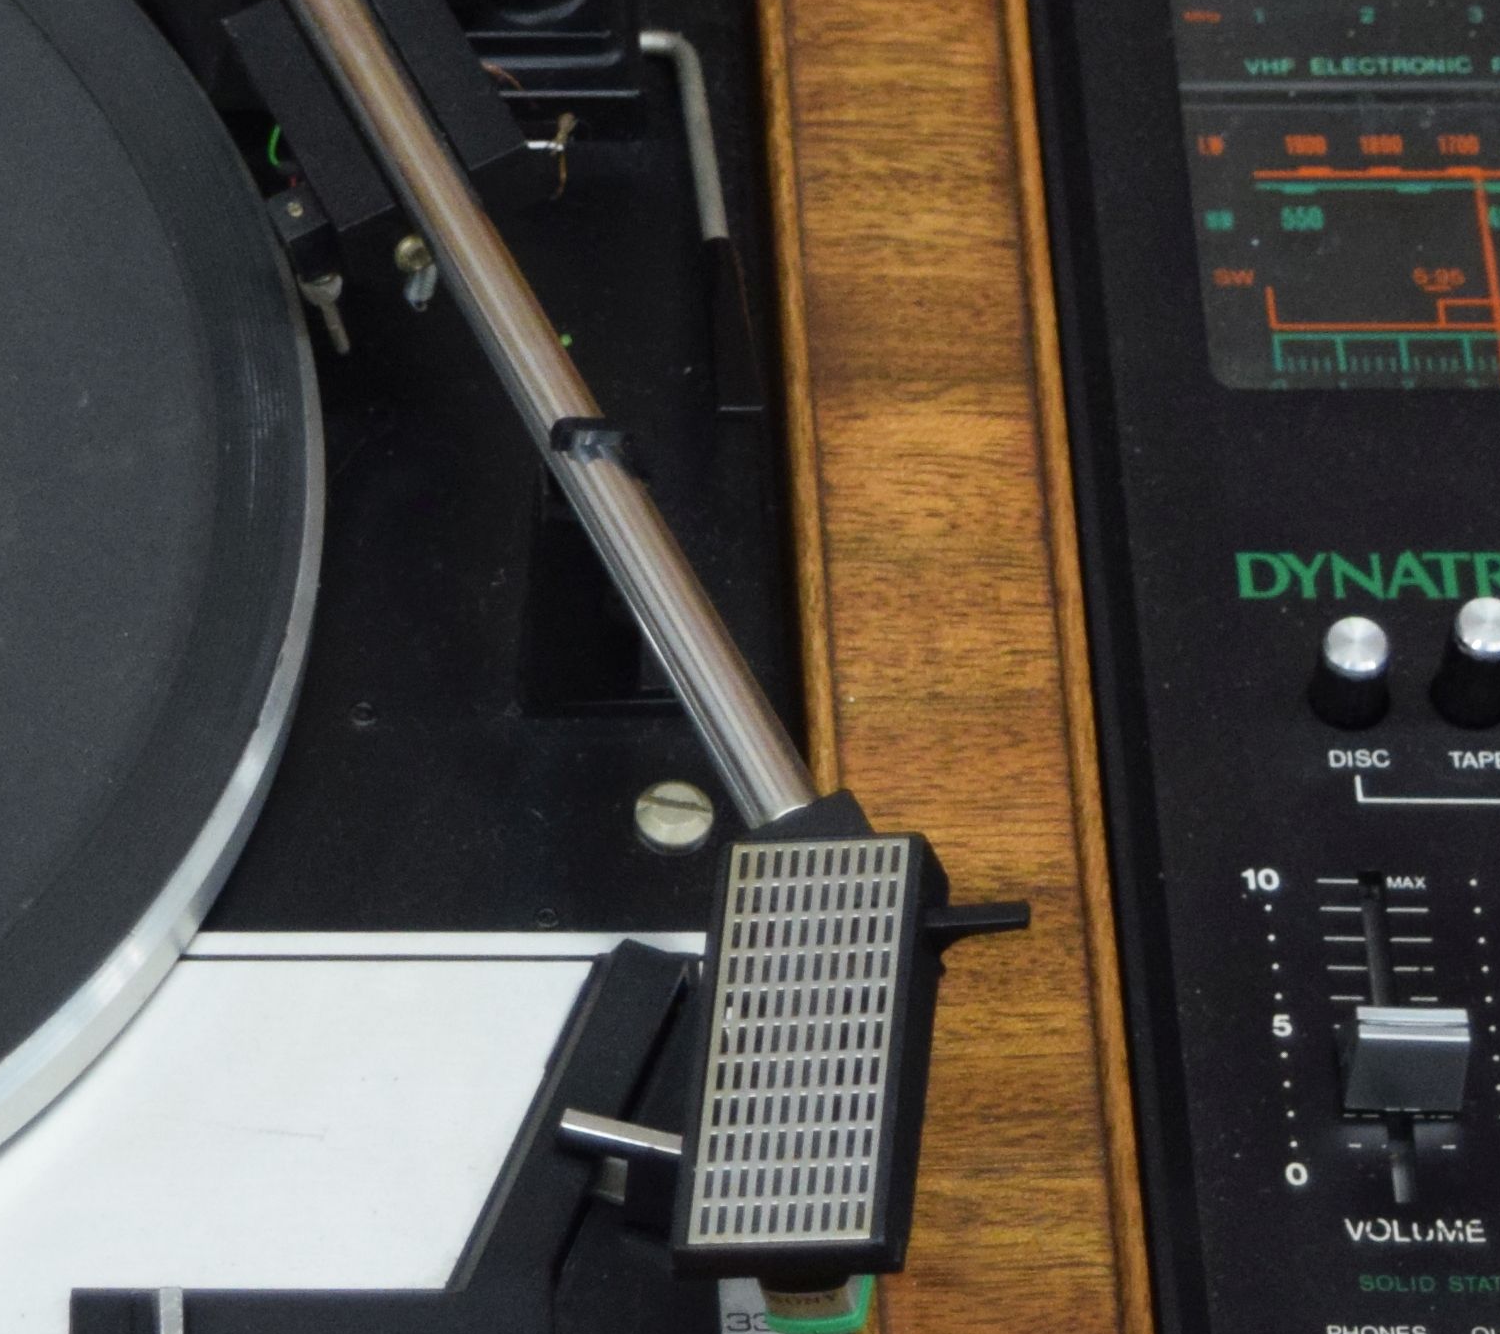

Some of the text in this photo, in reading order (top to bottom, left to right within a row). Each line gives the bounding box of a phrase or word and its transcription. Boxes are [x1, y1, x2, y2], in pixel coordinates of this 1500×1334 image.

[1254, 8, 1265, 23] 1
[1360, 7, 1374, 24] 2
[1469, 6, 1484, 23] 3
[1245, 58, 1294, 75] VHF
[1310, 56, 1471, 75] ELECTRONIC
[1328, 749, 1390, 768] DISC
[1242, 868, 1280, 891] 10
[1386, 876, 1426, 889] MAX
[1273, 1014, 1293, 1037] 5
[1285, 1162, 1308, 1186] 0
[1345, 1218, 1486, 1243] VOLUME
[1359, 1274, 1436, 1293] SOLID
